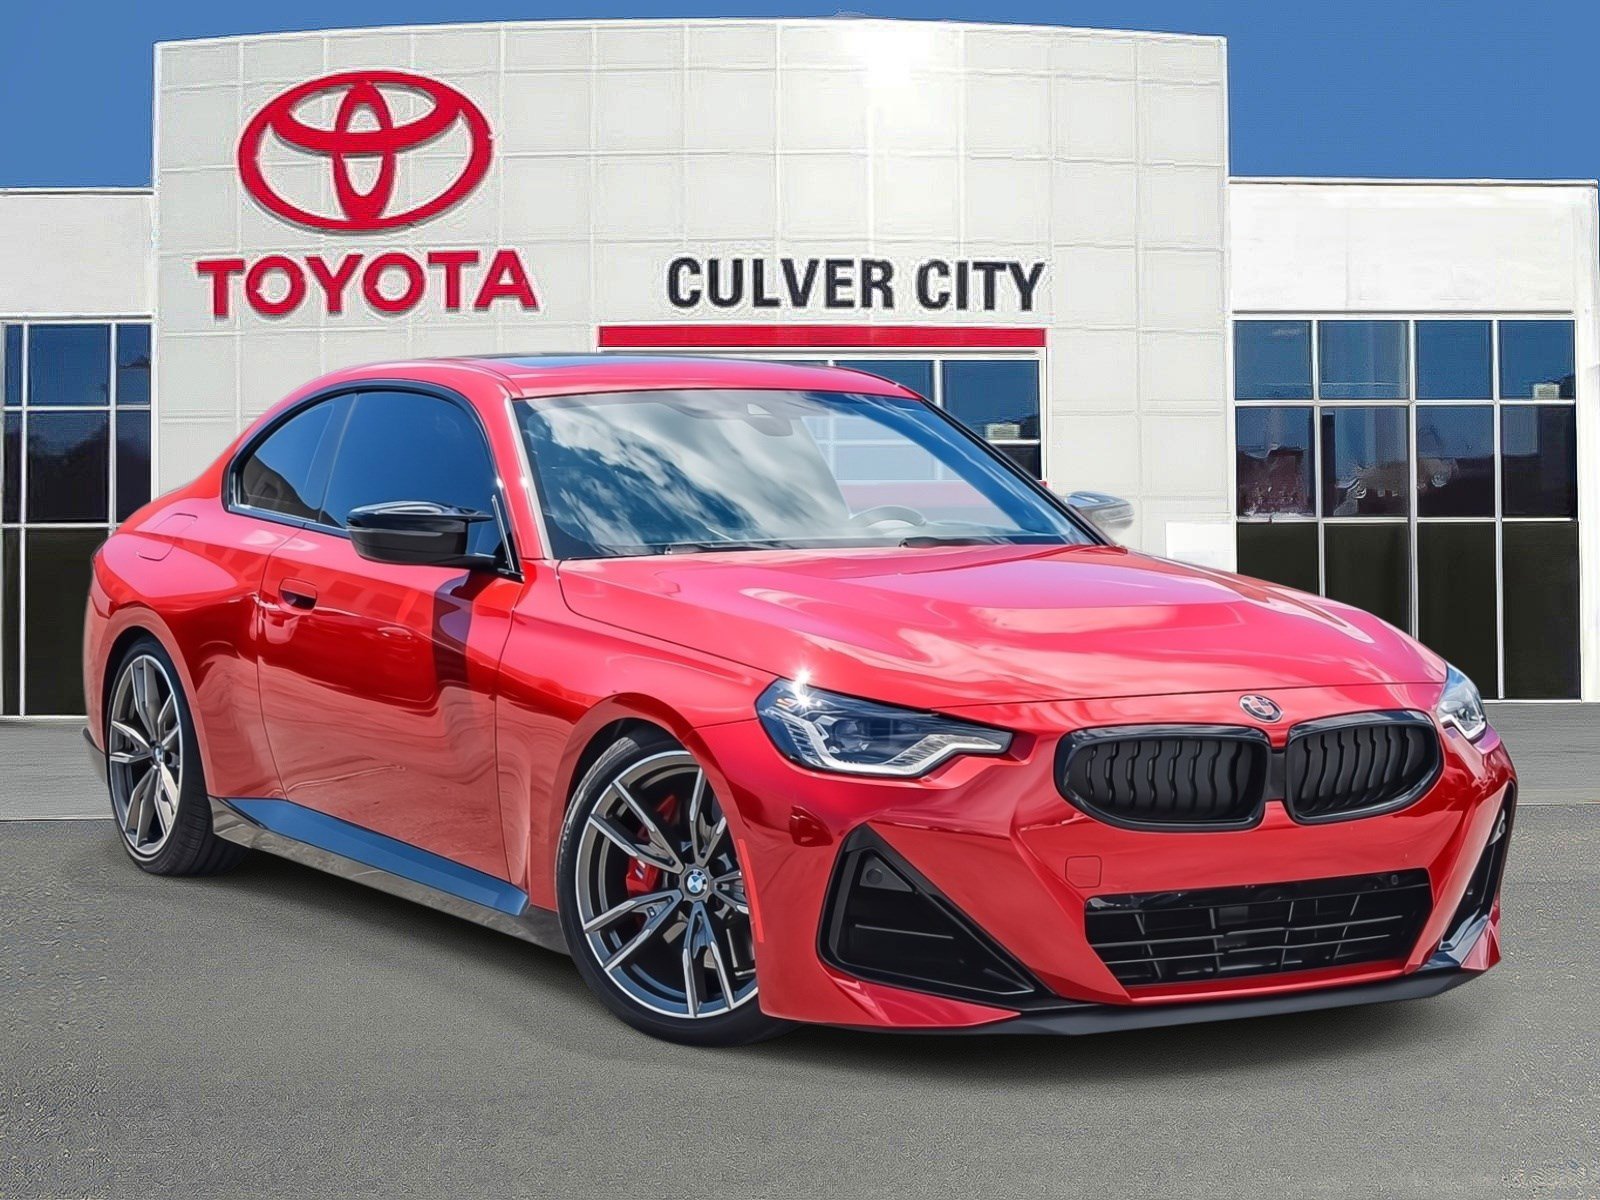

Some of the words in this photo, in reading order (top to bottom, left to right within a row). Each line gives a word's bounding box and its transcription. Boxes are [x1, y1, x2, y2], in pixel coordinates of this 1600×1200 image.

[196, 249, 538, 318] TOYOTA
[668, 256, 894, 309] CULVER
[916, 260, 1045, 311] CITY
